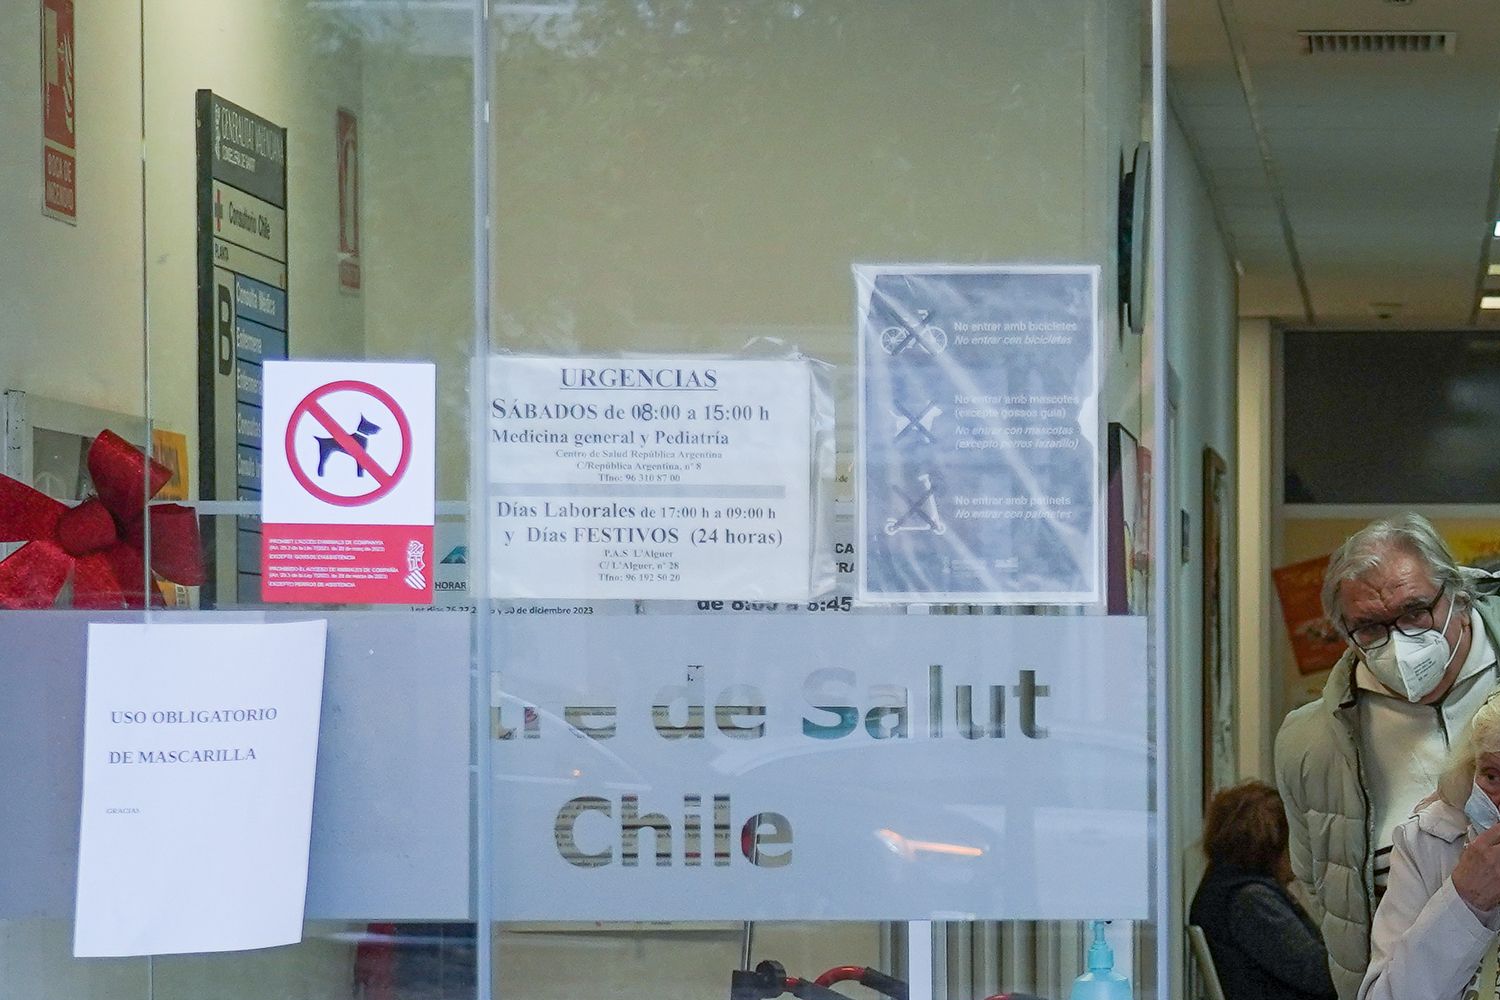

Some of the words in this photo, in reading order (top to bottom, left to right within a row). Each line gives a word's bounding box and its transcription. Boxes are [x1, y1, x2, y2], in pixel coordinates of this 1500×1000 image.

[219, 284, 232, 376] B
[954, 322, 969, 331] No
[955, 336, 969, 345] No
[561, 367, 718, 388] URGENCIAS
[491, 397, 598, 420] SÁBADOS
[604, 404, 625, 420] de
[632, 404, 681, 421] 08:00
[688, 409, 697, 421] a
[705, 404, 752, 421] 15:00
[759, 404, 769, 421] h
[492, 428, 568, 444] Medicina
[574, 430, 635, 448] general
[640, 434, 649, 448] y
[655, 431, 729, 445] Pediatría
[556, 450, 587, 458] Centro
[589, 450, 600, 458] de
[602, 450, 628, 458] Salud
[631, 450, 675, 459] República
[679, 451, 723, 460] Argentina
[955, 496, 970, 505] No
[497, 501, 537, 518] Días
[544, 502, 635, 519] Laborales
[640, 506, 656, 519] de
[661, 506, 697, 519] 17:00
[702, 506, 710, 519] h
[714, 510, 722, 519] a
[726, 506, 763, 519] 09:00
[768, 506, 776, 519] h
[955, 510, 970, 519] No
[503, 532, 515, 546] y
[528, 527, 567, 544] Días
[574, 527, 679, 544] FESTIVOS
[691, 527, 719, 547] (24
[726, 527, 783, 547] horas)
[669, 562, 680, 570] 28
[517, 607, 528, 615] de
[529, 607, 571, 615] diciembre
[573, 607, 594, 615] 2023
[652, 665, 767, 740] de
[802, 665, 1051, 740] Salut
[111, 710, 147, 725] USO
[152, 707, 278, 724] OBLIGATORIO
[108, 751, 134, 764] DE
[138, 748, 257, 763] MASCARILLA
[554, 792, 794, 868] Chile
